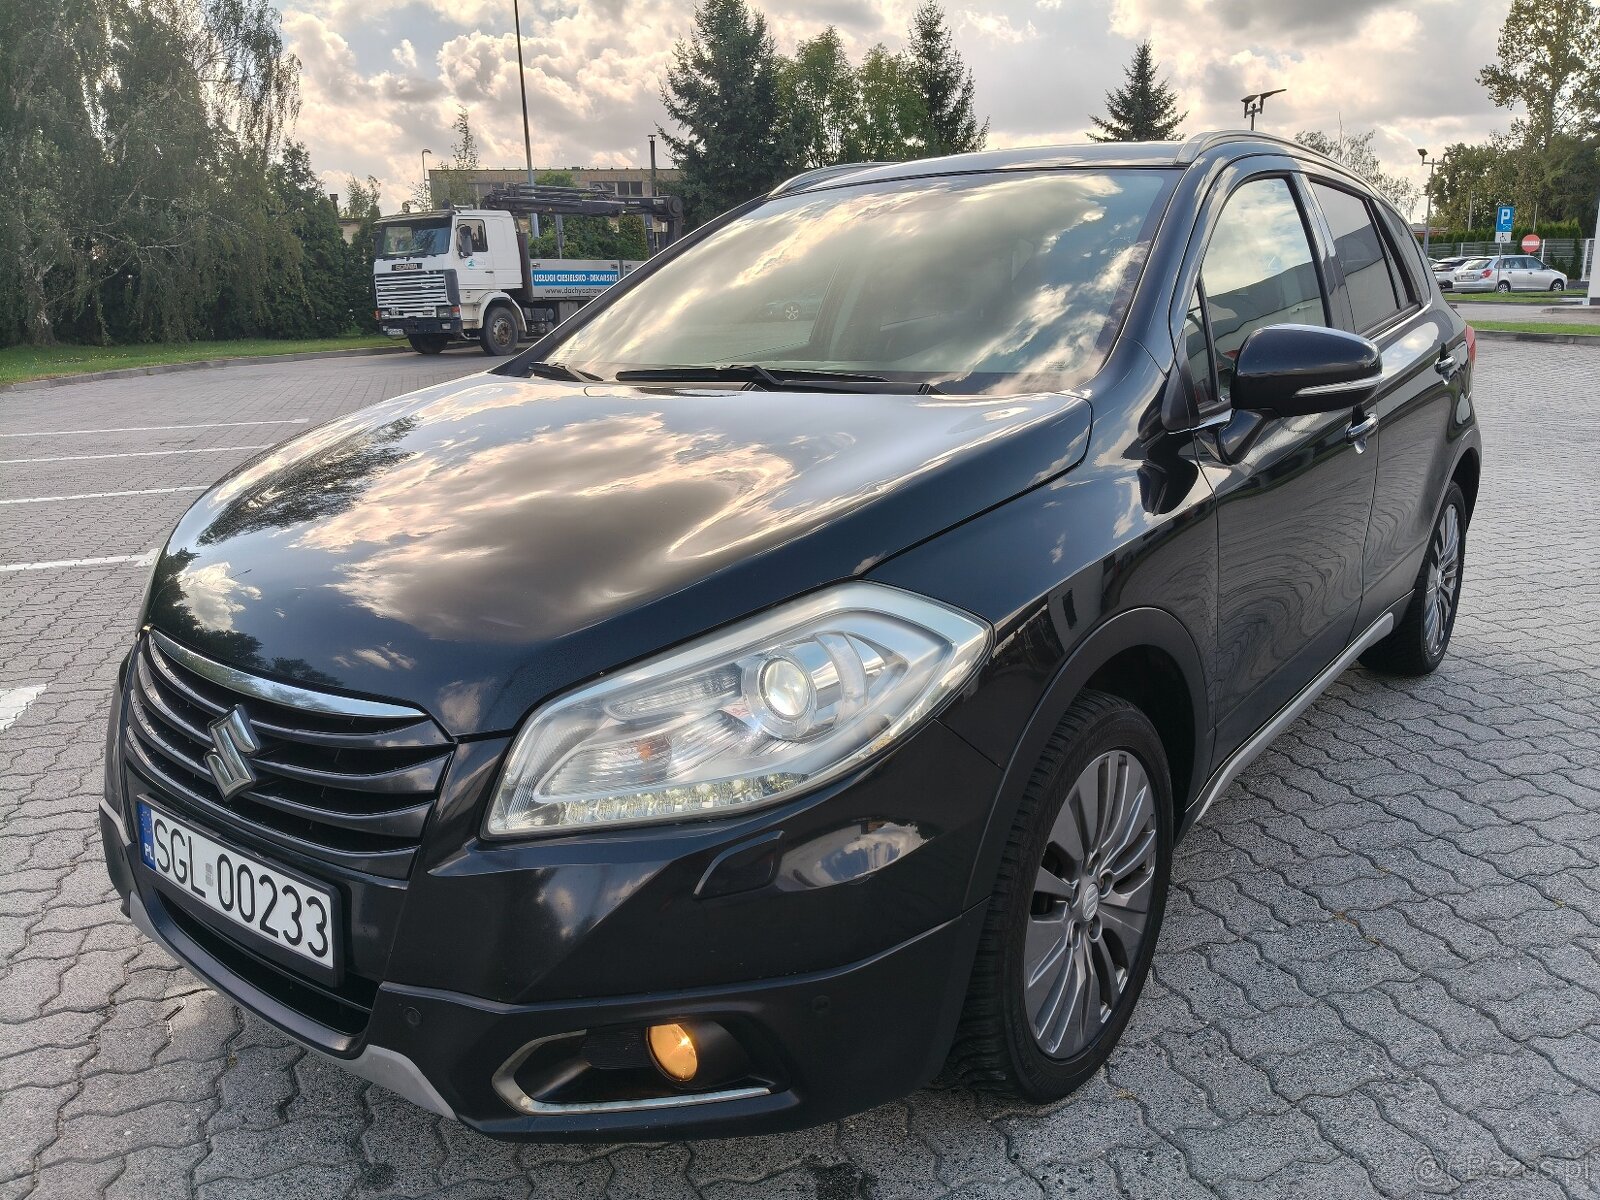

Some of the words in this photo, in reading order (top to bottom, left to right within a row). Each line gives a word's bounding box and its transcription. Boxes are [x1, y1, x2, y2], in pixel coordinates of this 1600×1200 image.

[1501, 209, 1511, 224] P
[557, 274, 587, 282] CIESIELSKO
[144, 842, 154, 861] PL
[154, 818, 207, 900] SGL
[216, 853, 329, 959] 00233
